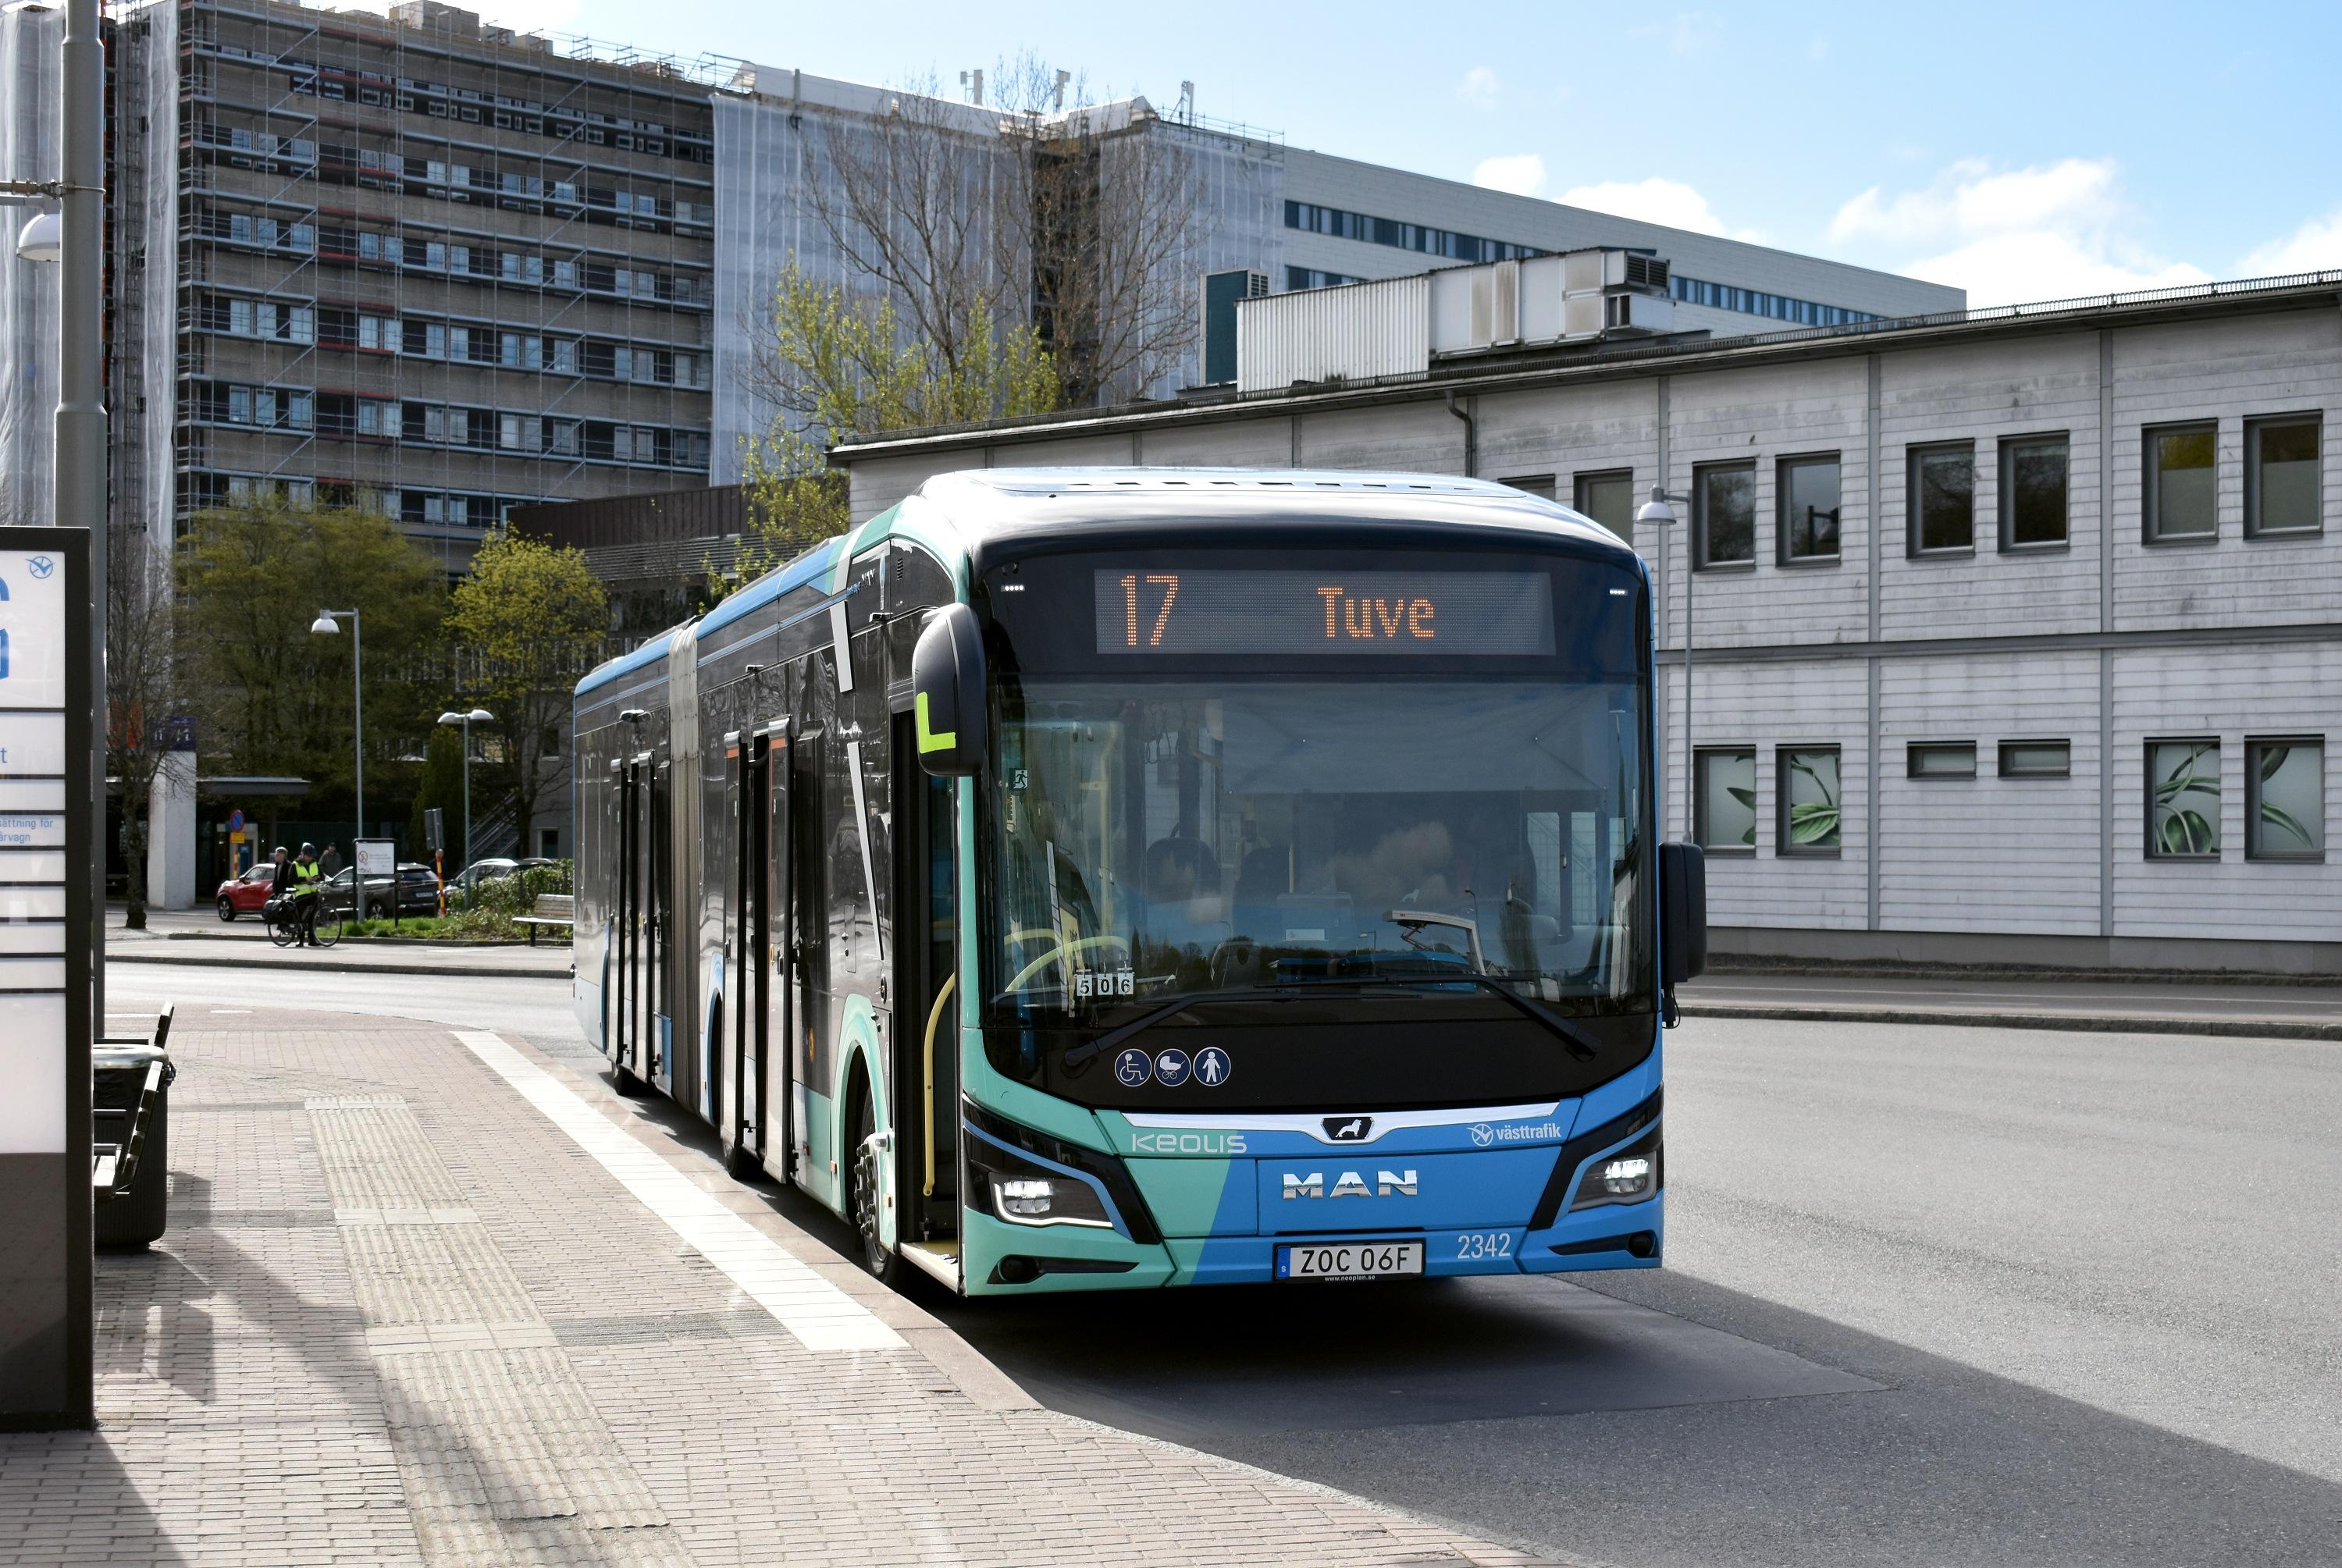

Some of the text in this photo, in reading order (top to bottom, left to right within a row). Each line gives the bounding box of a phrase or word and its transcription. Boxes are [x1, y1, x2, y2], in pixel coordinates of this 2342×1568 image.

[1120, 574, 1436, 646] 17 Tuve
[41, 818, 54, 828] för
[1080, 979, 1130, 994] 506
[1496, 1123, 1561, 1140] västtrafik
[1283, 1169, 1418, 1200] MAN
[1458, 1232, 1511, 1260] 2342
[1301, 1249, 1351, 1274] ZOC
[1361, 1246, 1410, 1271] 06F
[1324, 1274, 1376, 1282] www.neoplan.se
